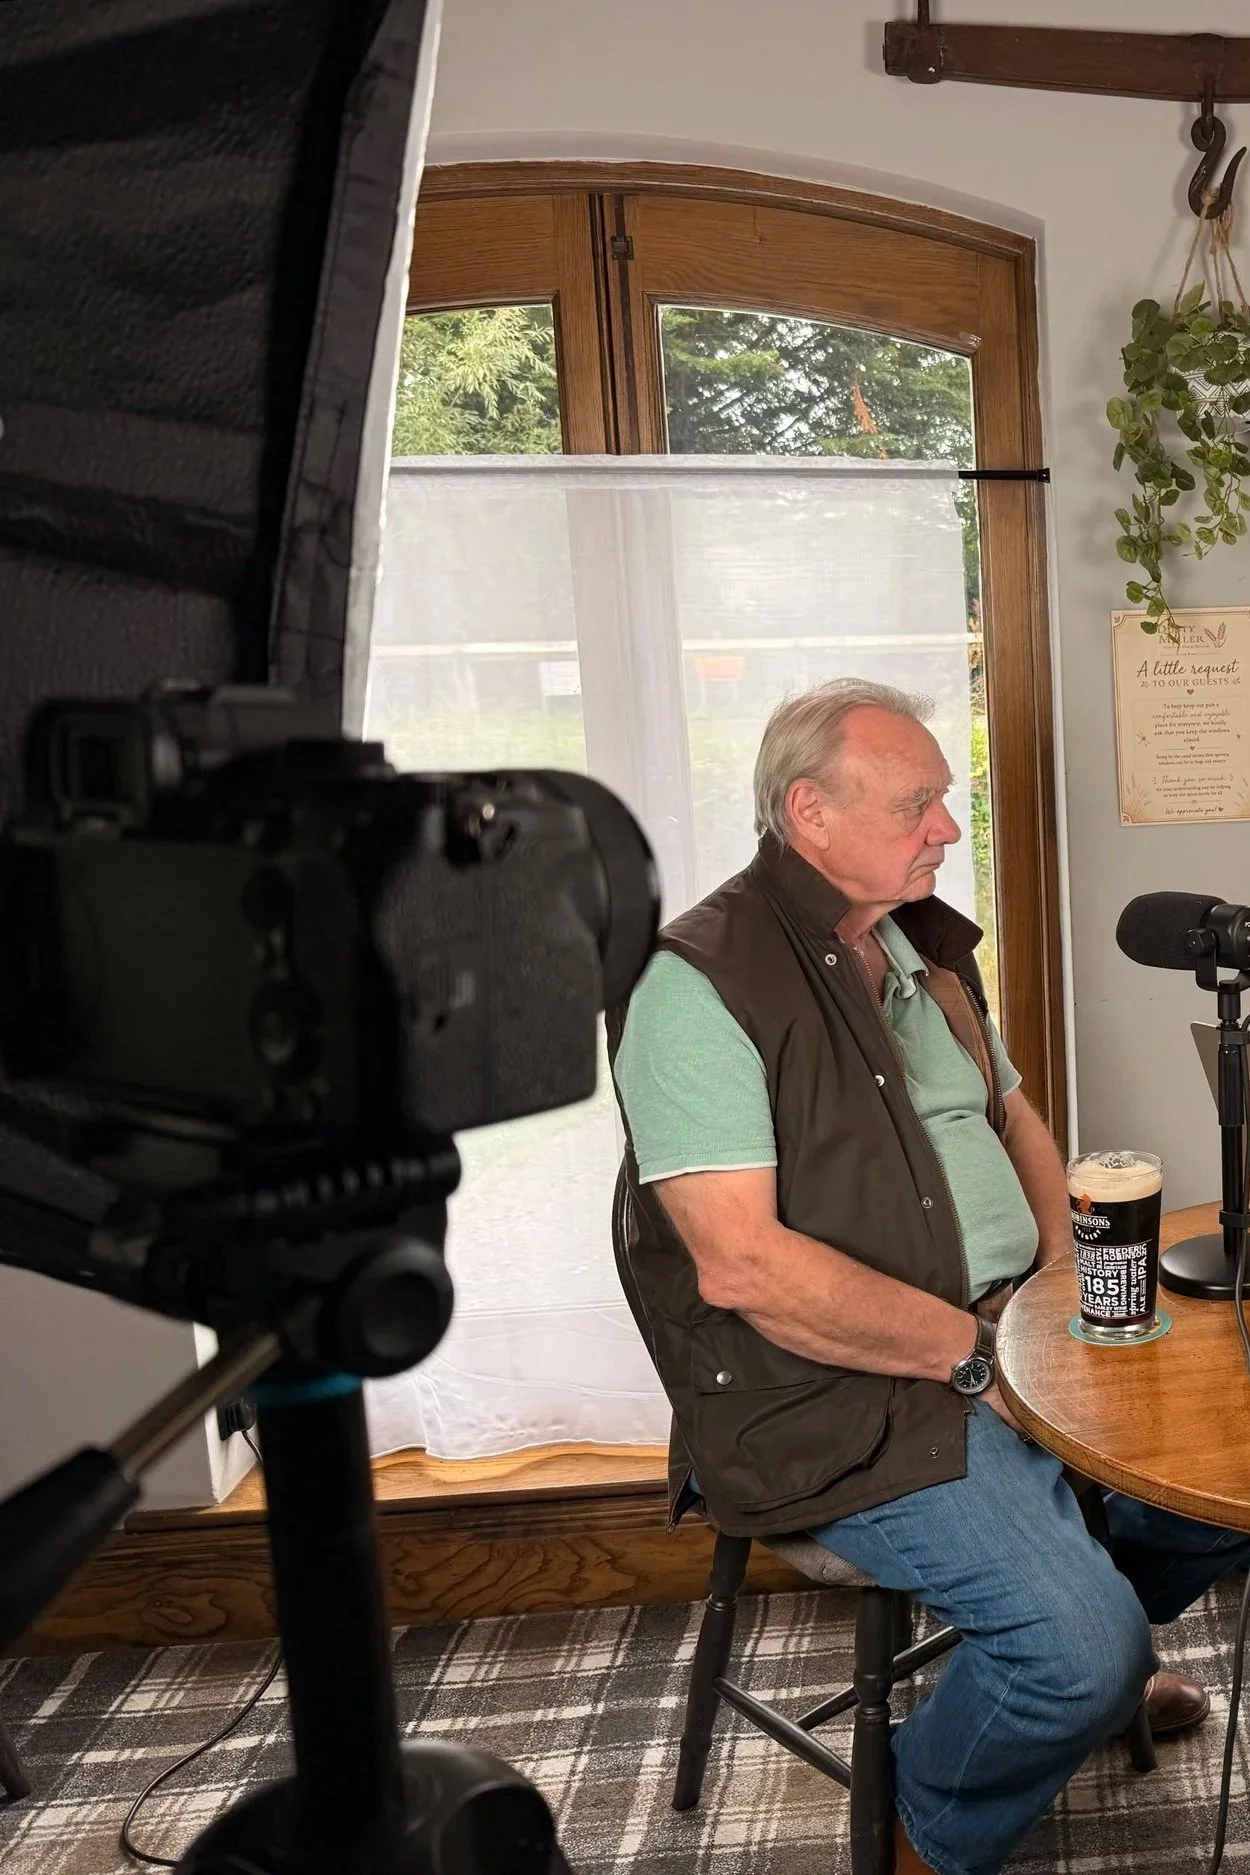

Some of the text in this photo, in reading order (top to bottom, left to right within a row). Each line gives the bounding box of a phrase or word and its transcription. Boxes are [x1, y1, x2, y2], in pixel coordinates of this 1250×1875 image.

[1158, 625, 1196, 634] DUTY
[1159, 635, 1205, 644] MLER
[1137, 658, 1240, 679] A little request
[1152, 677, 1229, 687] TO OUR GUESTS
[1103, 1243, 1147, 1256] FREDERIC
[1103, 1249, 1147, 1261] ROBINSON
[1080, 1264, 1119, 1278] HISTORY
[1137, 1256, 1147, 1280] IPA
[1084, 1275, 1120, 1296] 185
[1120, 1269, 1128, 1306] BREWING
[1082, 1291, 1119, 1307] YEARS
